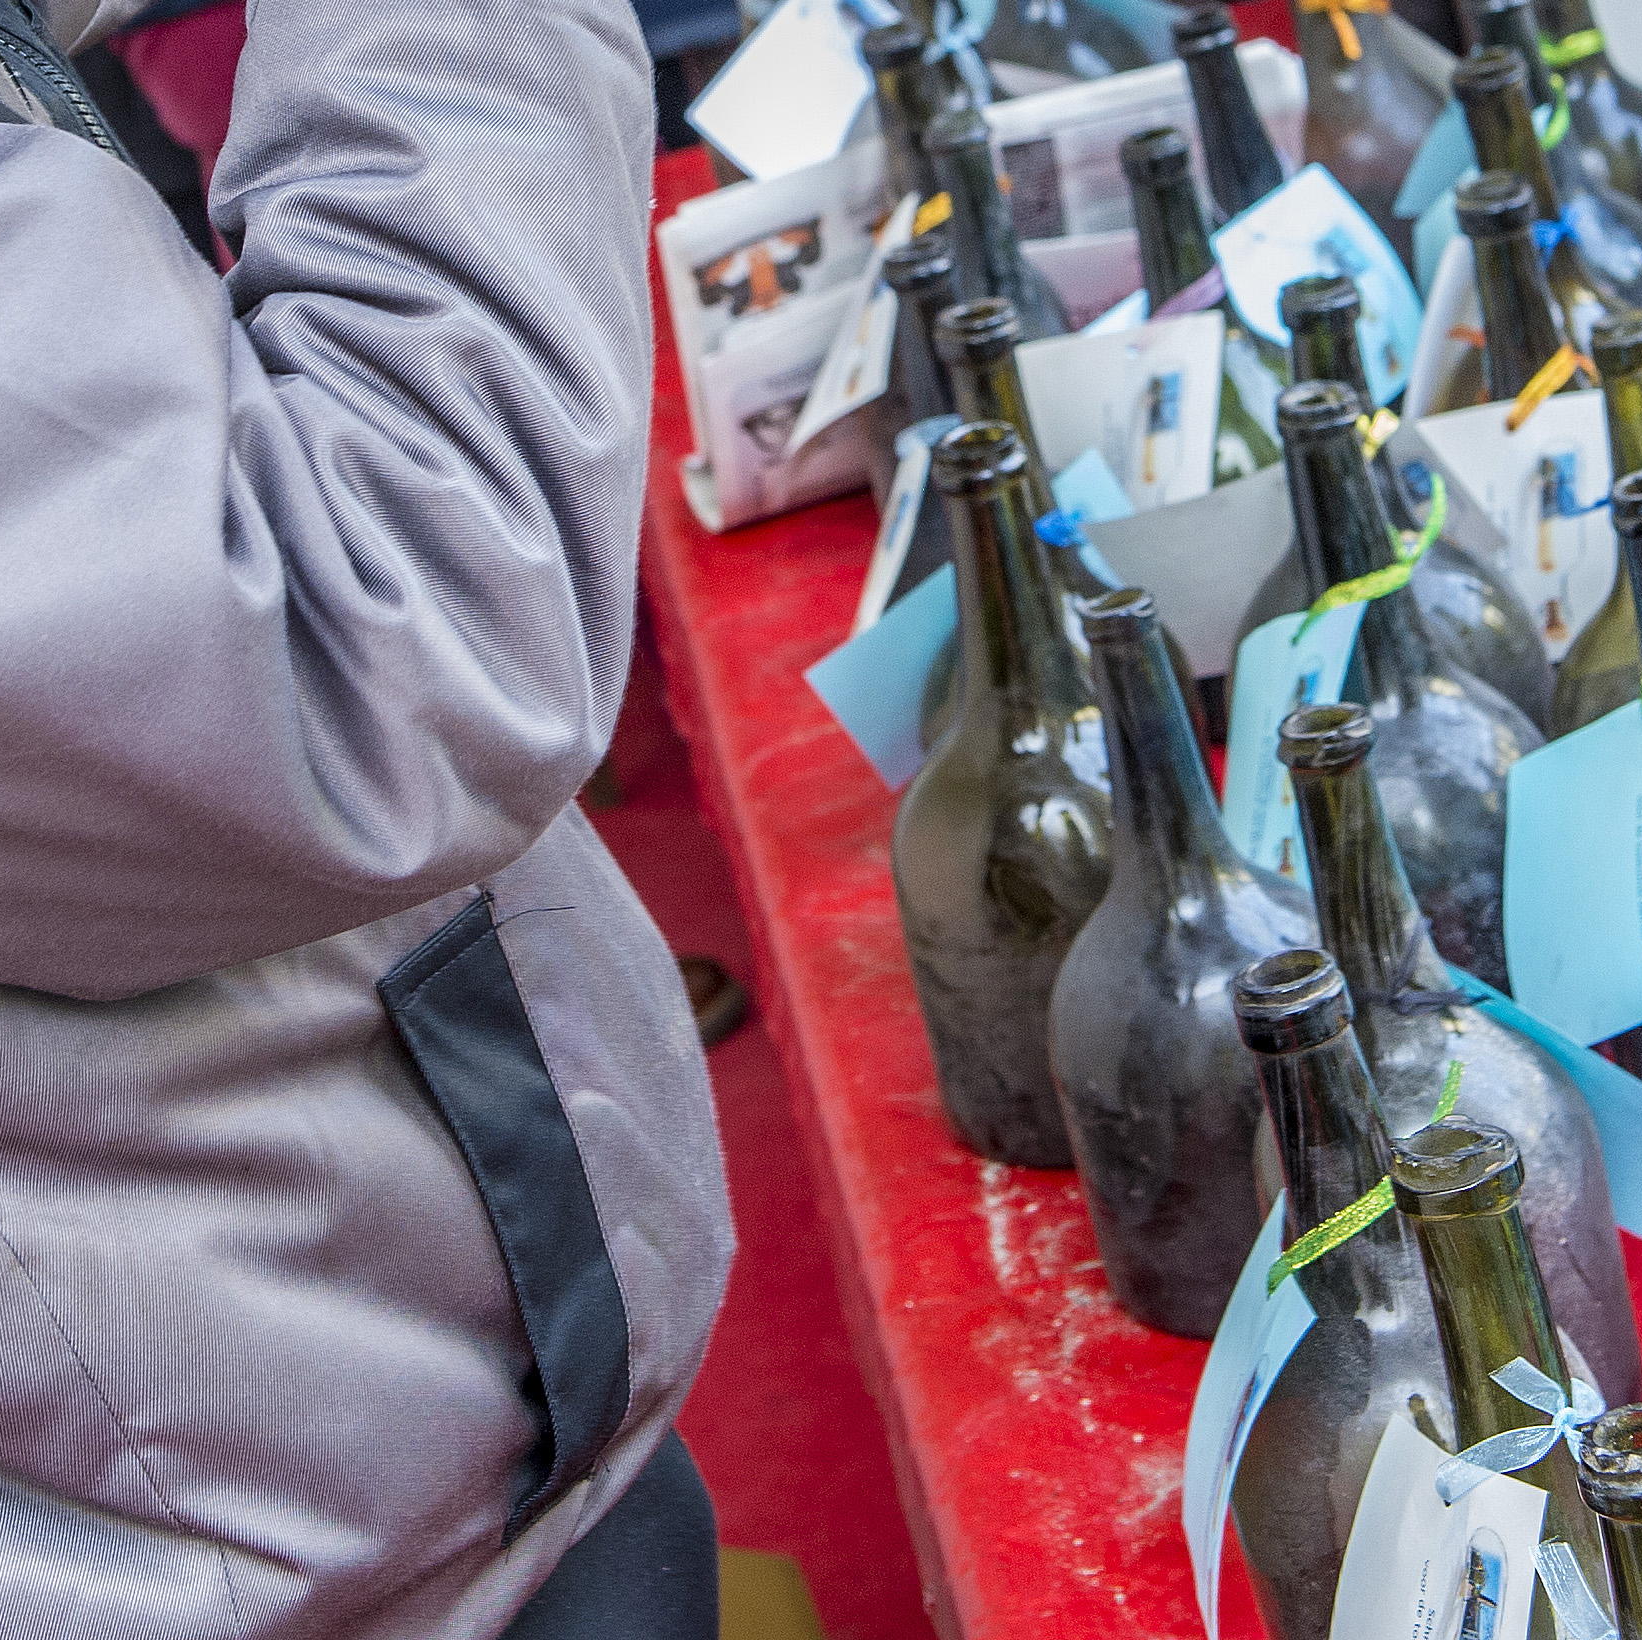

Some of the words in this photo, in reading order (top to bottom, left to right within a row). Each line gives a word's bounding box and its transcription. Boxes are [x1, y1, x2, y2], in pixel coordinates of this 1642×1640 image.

[1421, 1560, 1429, 1595] voor
[1418, 1599, 1425, 1618] de
[1424, 1608, 1435, 1640] Schr
